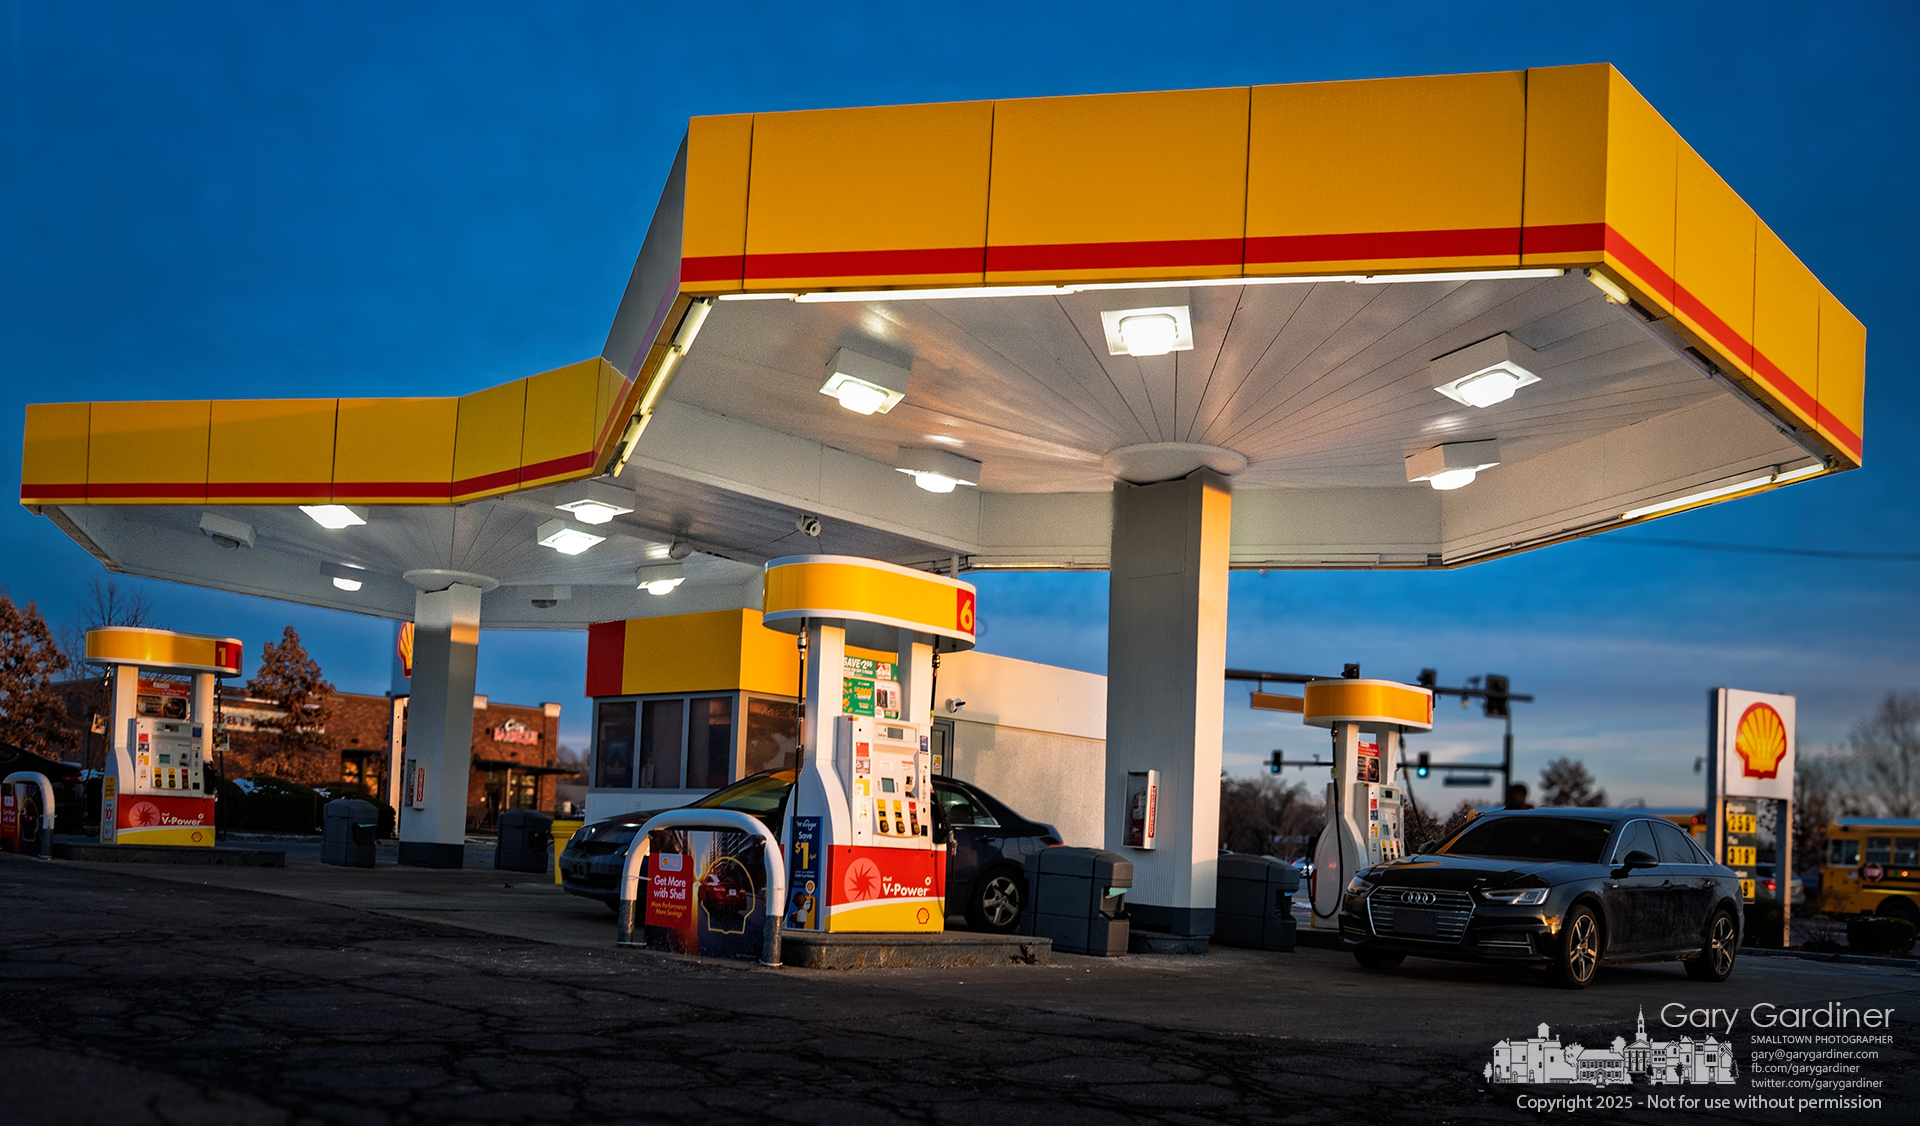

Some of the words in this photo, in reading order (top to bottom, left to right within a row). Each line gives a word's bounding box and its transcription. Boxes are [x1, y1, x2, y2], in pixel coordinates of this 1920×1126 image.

[960, 599, 973, 631] 6
[218, 647, 226, 665] 1
[161, 815, 201, 826] V-Power
[798, 831, 813, 840] Save
[653, 875, 667, 886] Get
[667, 876, 687, 888] More
[653, 887, 668, 899] with
[669, 888, 686, 900] Shell
[882, 883, 928, 897] V-Power
[662, 901, 687, 910] Performance
[655, 908, 666, 916] More
[667, 909, 683, 918] Savings
